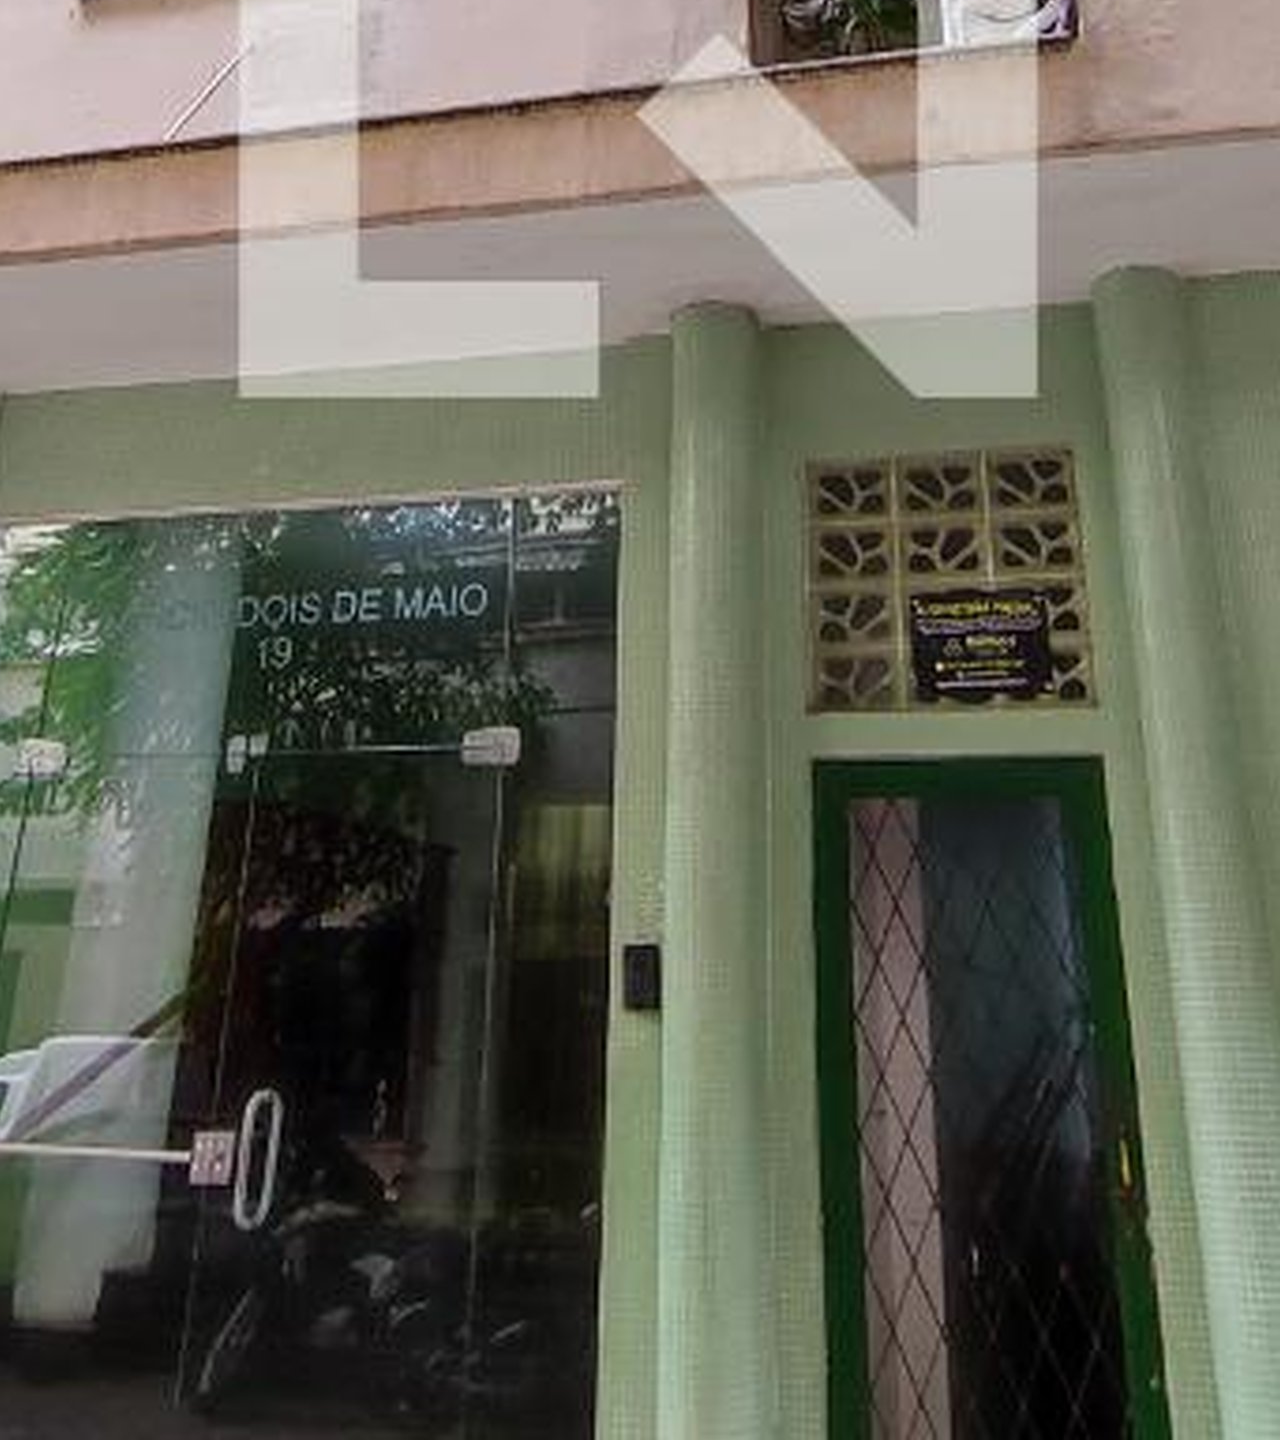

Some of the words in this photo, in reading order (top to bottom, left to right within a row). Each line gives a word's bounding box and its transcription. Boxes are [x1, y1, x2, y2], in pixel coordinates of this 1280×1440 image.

[237, 594, 321, 628] DOIS
[331, 588, 383, 624] DE
[395, 583, 488, 619] MAIO
[259, 636, 292, 669] 19
